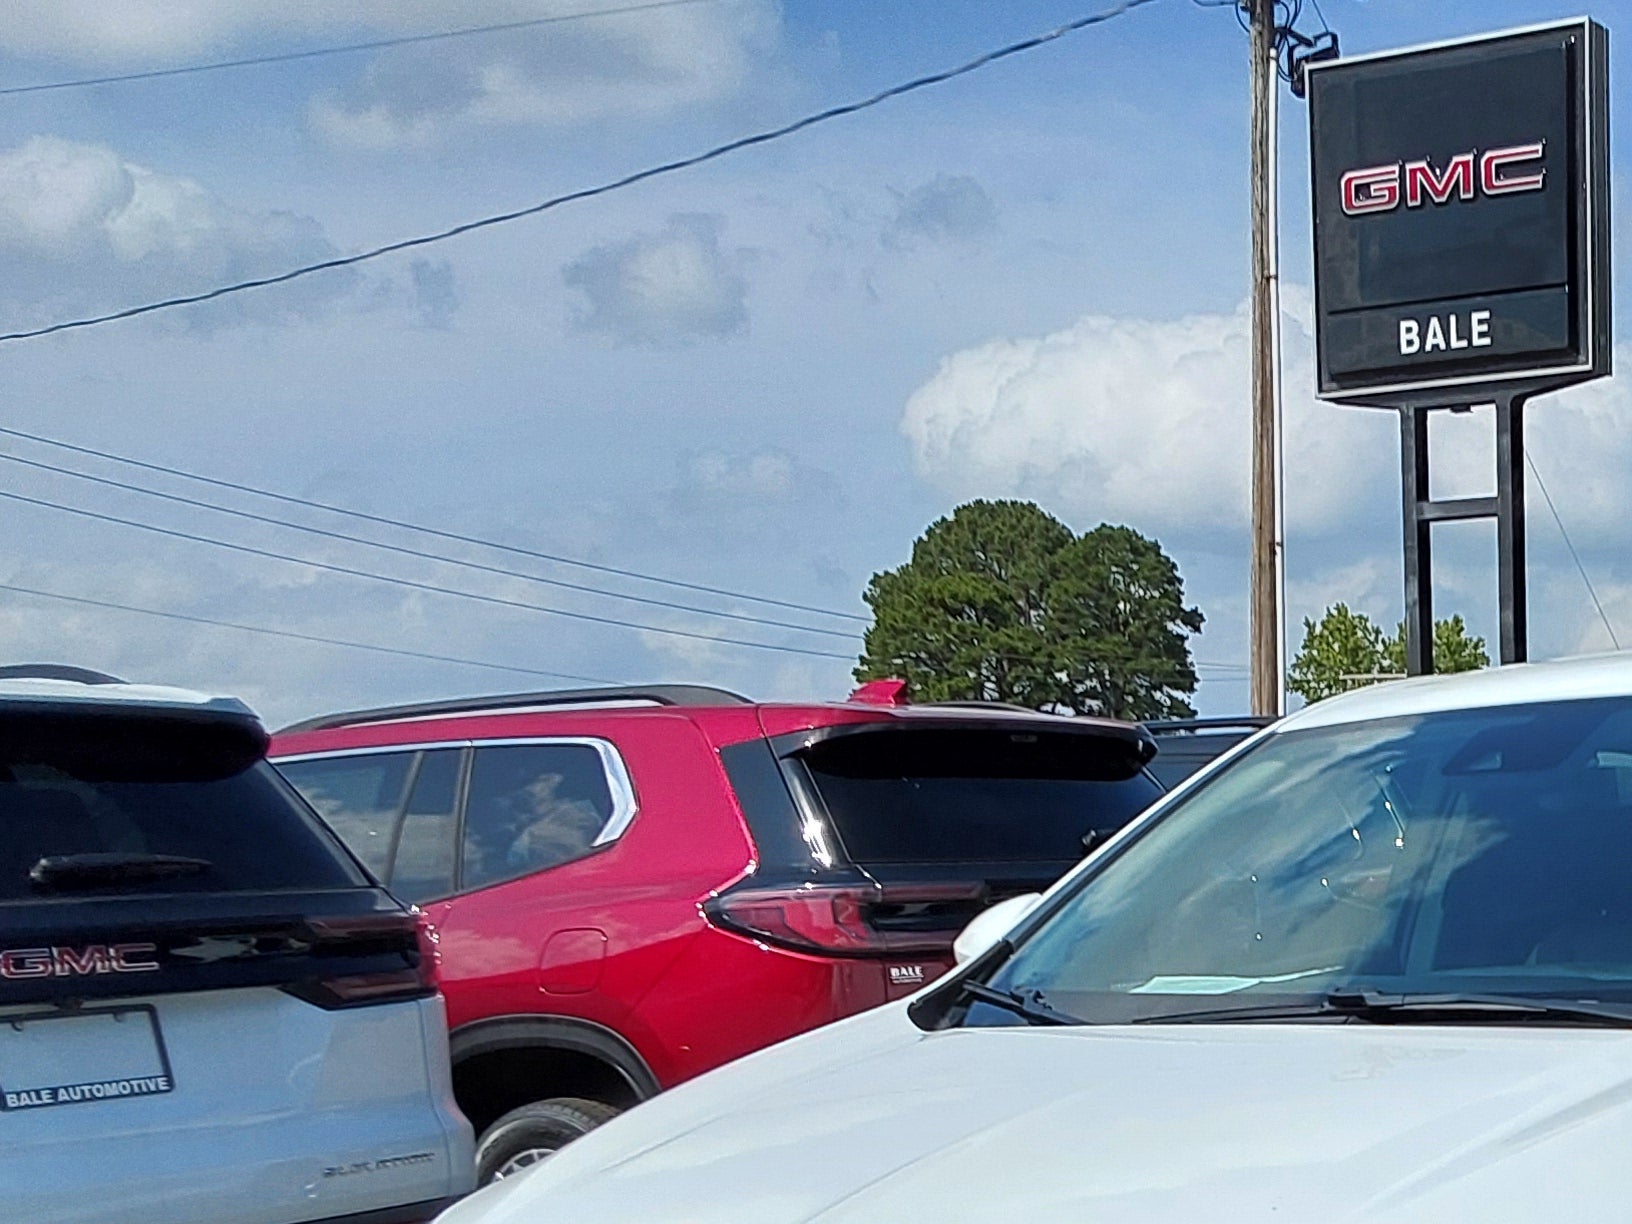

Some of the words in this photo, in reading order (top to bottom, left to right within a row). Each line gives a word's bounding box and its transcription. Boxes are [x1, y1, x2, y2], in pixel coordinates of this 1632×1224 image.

[1341, 143, 1543, 215] GMC
[1400, 310, 1492, 355] BALE
[0, 943, 160, 979] GMC
[890, 965, 922, 977] BALE
[6, 1089, 54, 1108] BALE
[57, 1077, 170, 1102] AUTOMOTIVE
